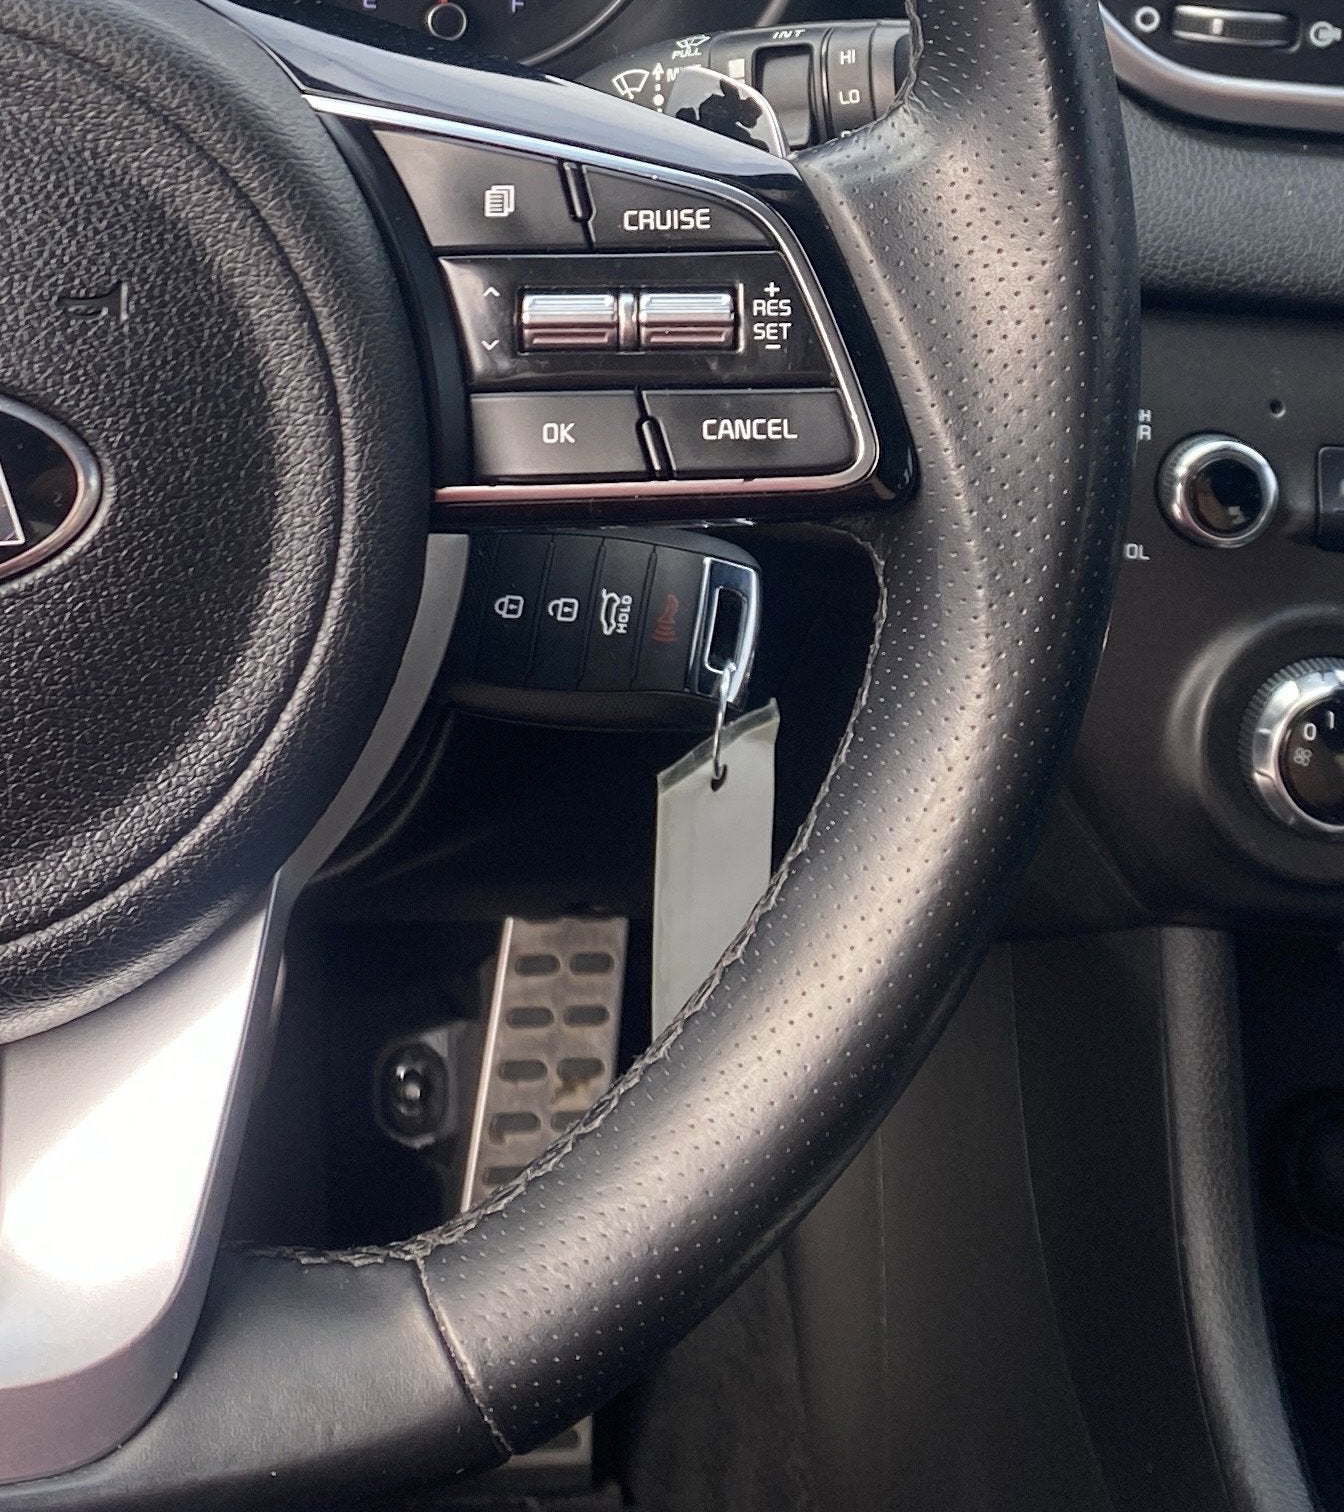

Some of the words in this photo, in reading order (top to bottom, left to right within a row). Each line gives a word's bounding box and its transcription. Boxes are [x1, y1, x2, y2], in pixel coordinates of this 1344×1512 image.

[773, 29, 806, 39] INT
[672, 47, 702, 59] PULL
[840, 49, 856, 65] HI
[839, 88, 860, 105] LO
[623, 208, 711, 231] CRUISE
[753, 298, 792, 317] RES
[753, 321, 792, 340] SET
[542, 423, 576, 444] OK
[702, 418, 798, 441] CANCEL
[1124, 543, 1150, 560] OL
[616, 595, 633, 633] HOLD
[1328, 711, 1335, 729] 1
[1303, 723, 1317, 741] 0
